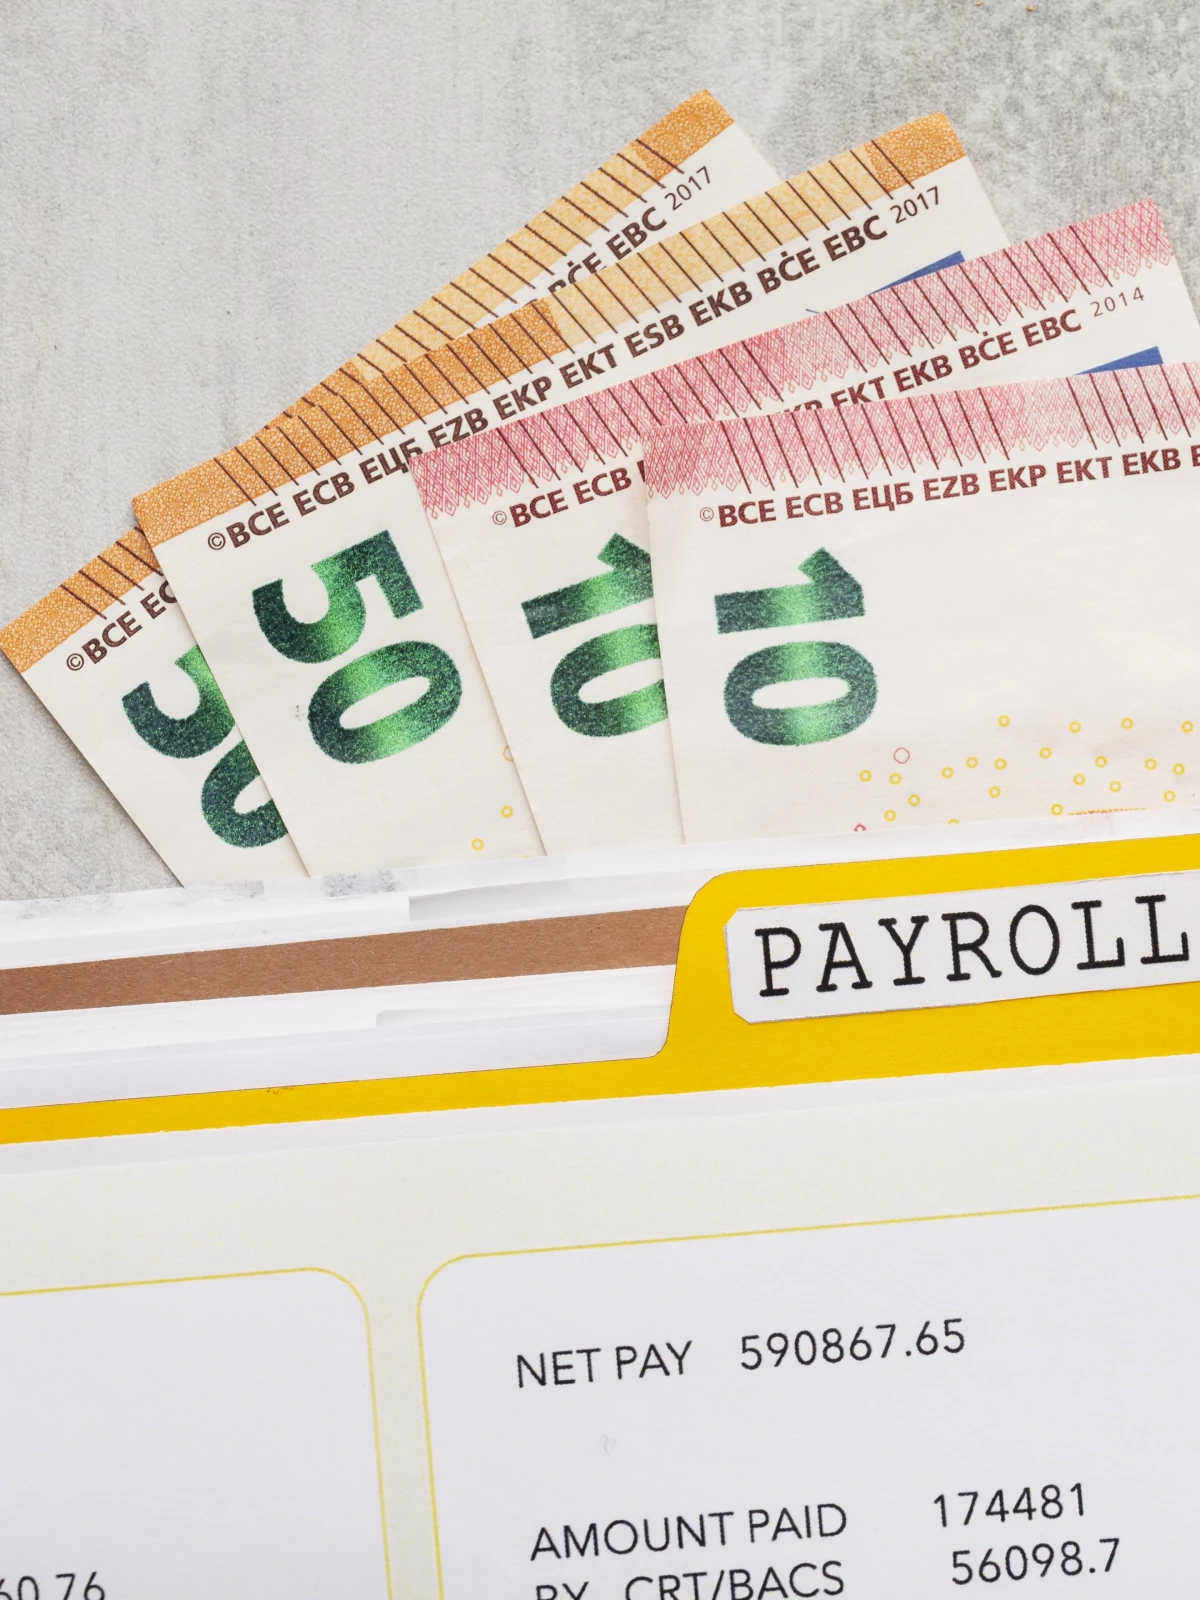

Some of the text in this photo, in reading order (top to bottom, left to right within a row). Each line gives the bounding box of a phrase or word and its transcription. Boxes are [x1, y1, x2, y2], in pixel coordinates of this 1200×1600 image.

[605, 206, 667, 260] EBC
[664, 165, 711, 211] 2017
[292, 471, 355, 516] ECB
[427, 408, 489, 449] EZB
[492, 375, 552, 421] EKP
[559, 344, 618, 389] EKT
[624, 314, 685, 358] ESB
[688, 281, 753, 327] EKB
[822, 215, 888, 261] EBC
[890, 186, 940, 224] 2017
[893, 354, 953, 392] EKB
[1021, 309, 1082, 347] EBC
[1090, 287, 1145, 318] 2014
[573, 467, 632, 505] ECB
[785, 491, 844, 519] ECB
[923, 472, 980, 502] EZB
[989, 464, 1047, 493] EKP
[1056, 456, 1113, 484] EKT
[1121, 448, 1181, 477] EKB
[252, 529, 463, 765] 50
[520, 532, 669, 738] 10
[713, 546, 879, 747] 10
[754, 894, 1191, 997] PAYROLL
[517, 1319, 965, 1388] NET PAY 590867.65
[531, 1483, 1083, 1561] AMOUNT PAID 174481
[626, 1561, 844, 1600] CRT/BACS
[952, 1538, 1120, 1585] 56098.7
